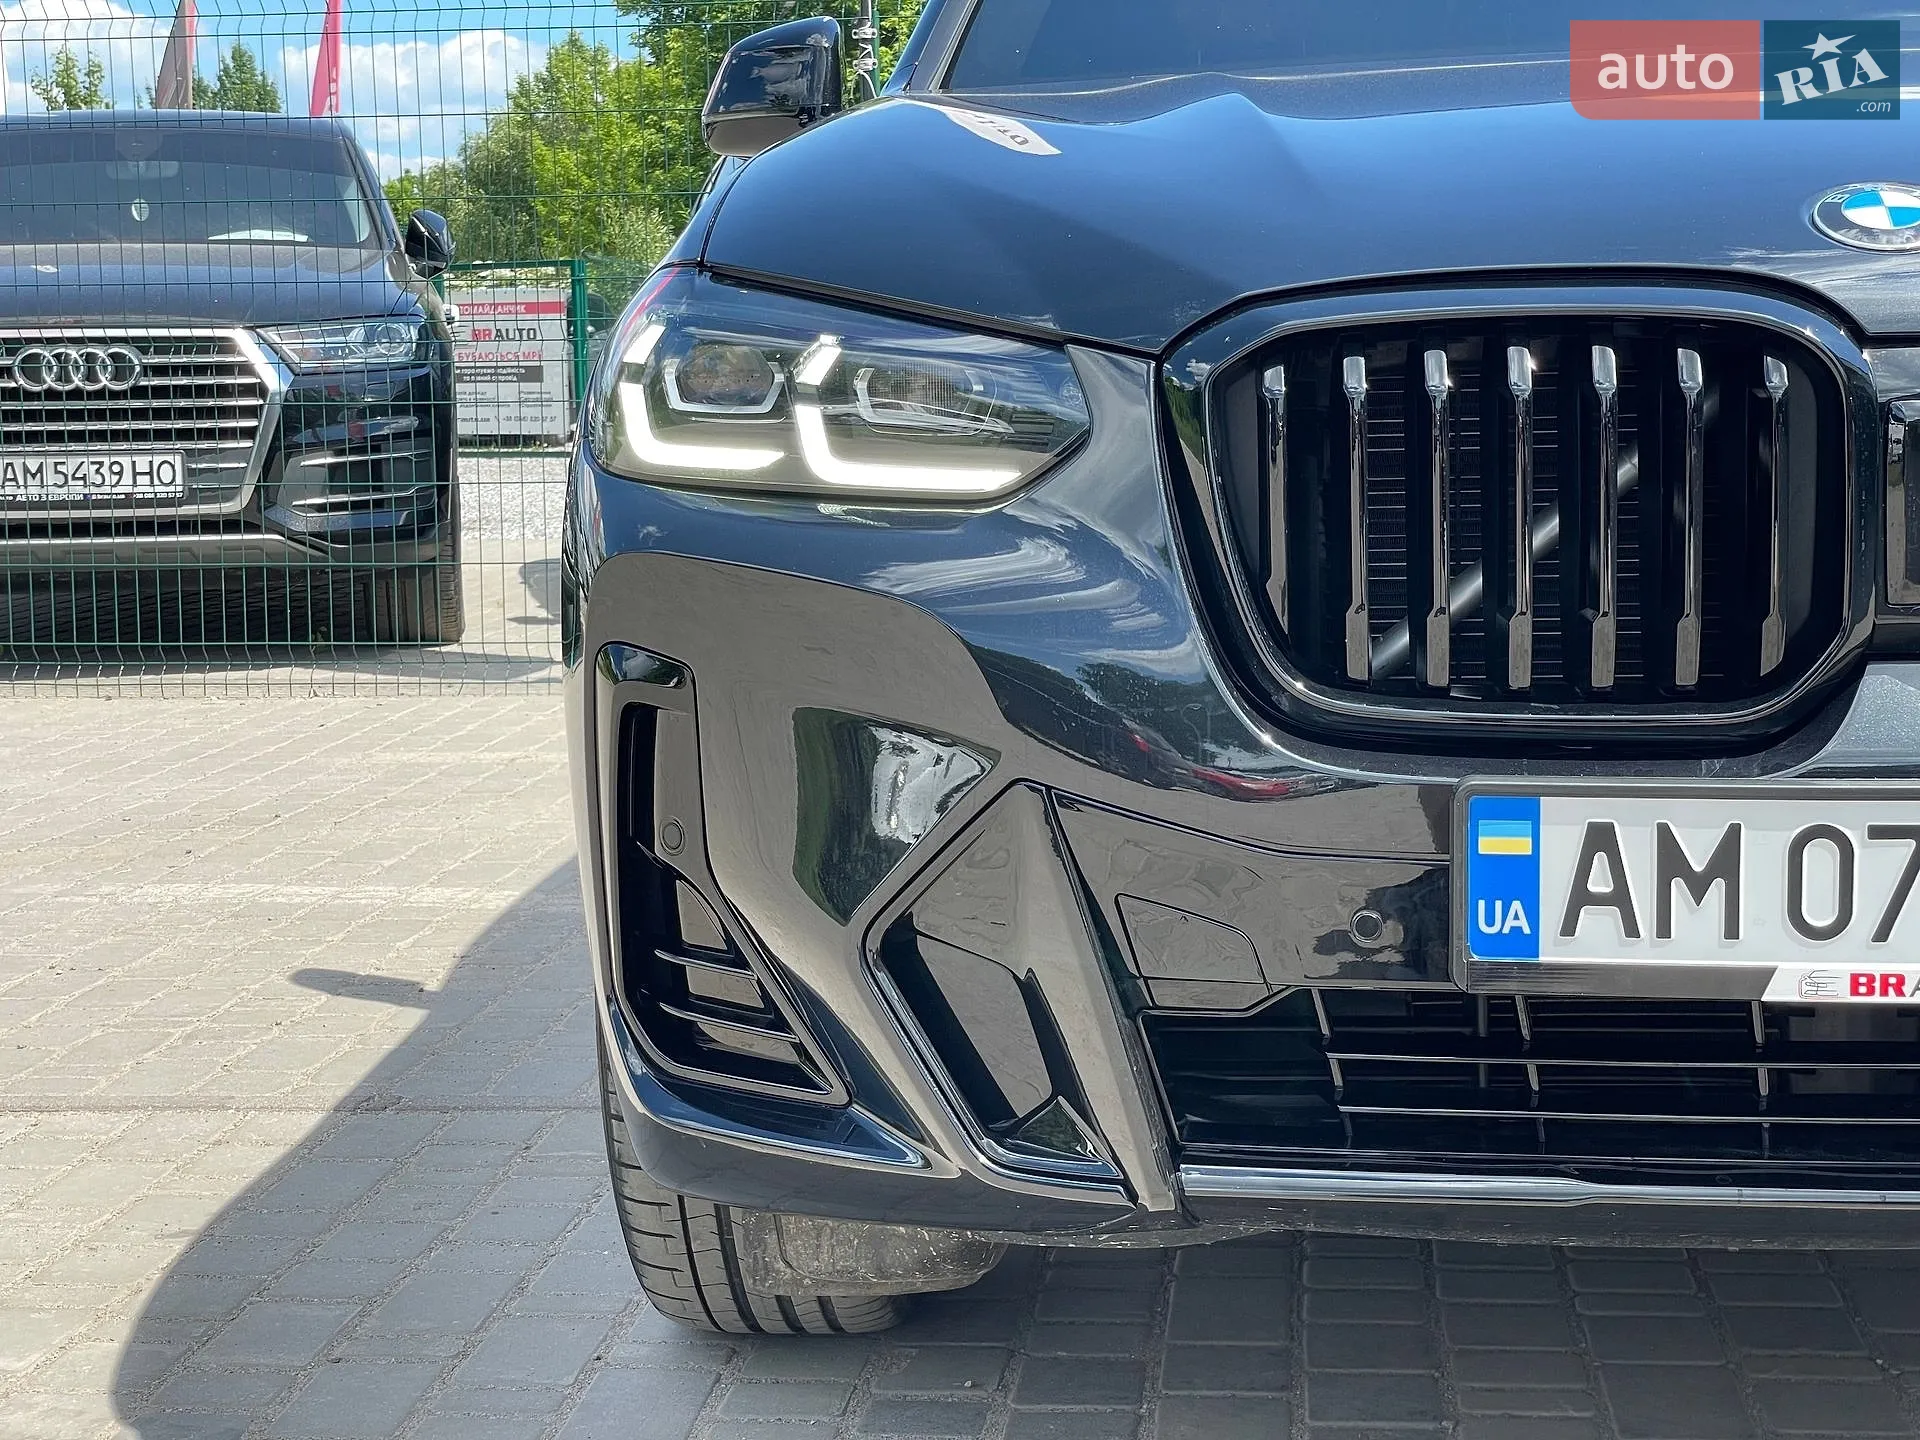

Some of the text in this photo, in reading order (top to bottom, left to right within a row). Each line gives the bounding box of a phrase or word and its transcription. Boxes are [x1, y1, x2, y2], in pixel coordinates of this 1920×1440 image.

[1, 460, 176, 488] AM 5439 HO
[1558, 820, 1920, 944] AM 07
[1477, 899, 1531, 935] UA
